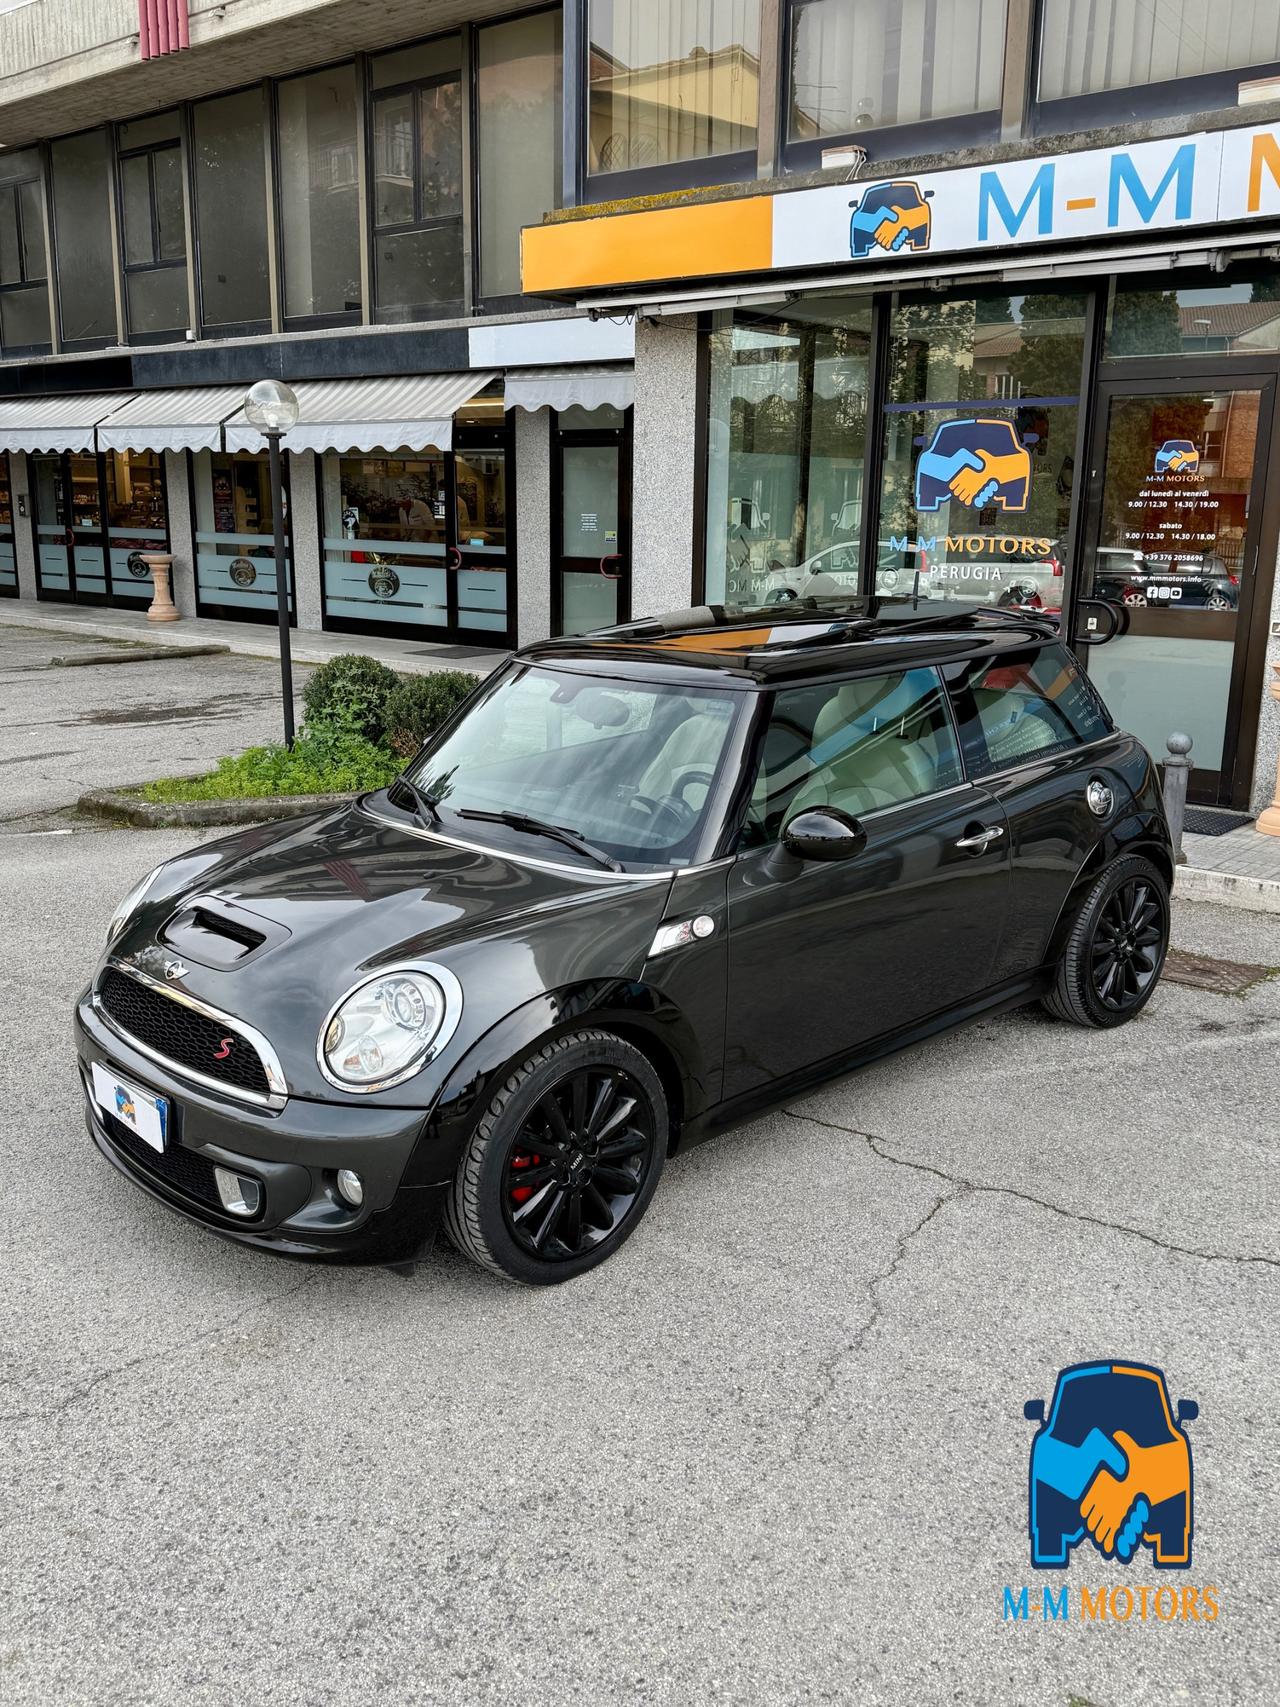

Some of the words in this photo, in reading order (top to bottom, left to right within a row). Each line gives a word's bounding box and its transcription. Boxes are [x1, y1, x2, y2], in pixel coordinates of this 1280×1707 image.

[978, 144, 1197, 241] M-M
[944, 536, 1052, 555] MOTORS
[930, 564, 1002, 581] PERUGIA
[213, 1038, 234, 1059] S
[570, 1152, 583, 1170] MINI
